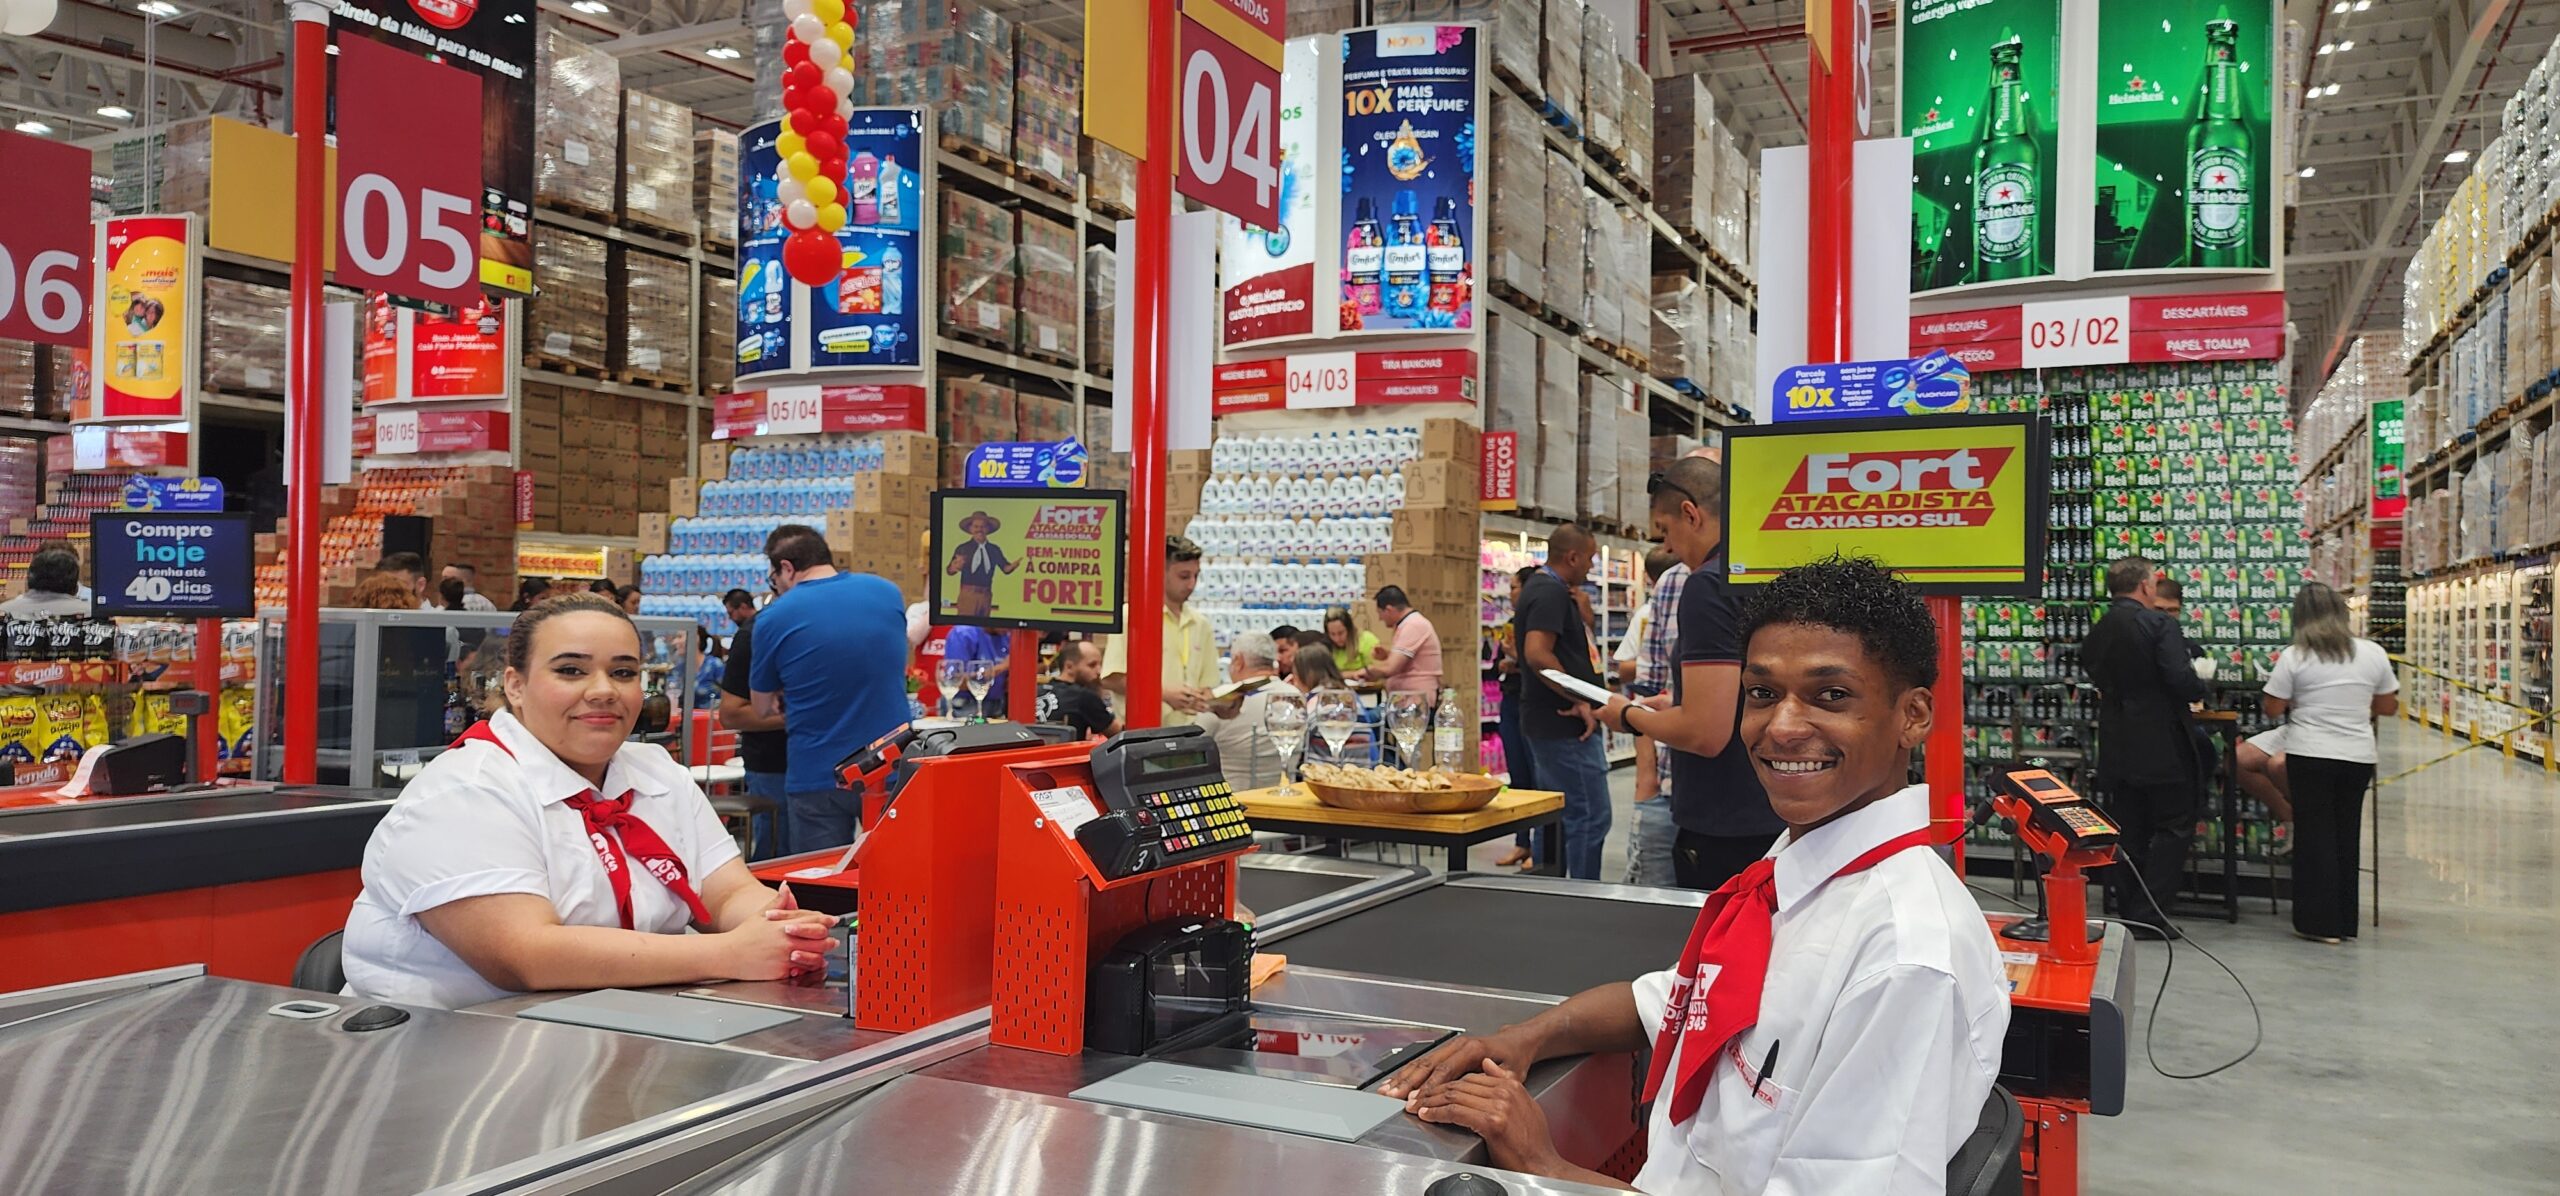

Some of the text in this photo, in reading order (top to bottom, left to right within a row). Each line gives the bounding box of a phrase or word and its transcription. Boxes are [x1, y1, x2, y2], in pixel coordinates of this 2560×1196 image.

[380, 15, 400, 34] da
[437, 36, 467, 57] para
[468, 48, 491, 67] sua
[491, 57, 523, 79] mesa
[1397, 86, 1434, 98] MAIS
[1345, 88, 1394, 116] 10X
[1183, 49, 1277, 209] 04
[344, 173, 473, 290] 05
[0, 243, 83, 334] 6
[2162, 305, 2249, 319] DESCARTÁVEIS
[1946, 319, 1988, 332] ROUPAS
[2166, 337, 2250, 351] PAPEL TOALHA
[1796, 369, 1826, 378] Parcele
[1786, 385, 1835, 409] 10x
[978, 460, 1008, 478] 10x
[1497, 436, 1514, 498] PREÇOS
[1807, 448, 1985, 494] Fort
[179, 478, 200, 493] 40
[1771, 491, 1994, 512] ATACADISTA
[1040, 505, 1099, 525] Fort
[1785, 513, 1969, 529] CAXIAS DO SUL
[125, 521, 213, 541] Compre
[1029, 525, 1101, 533] ATACADISTA
[137, 539, 206, 568] hoje
[1026, 547, 1101, 559] BEM-VINDO
[148, 567, 183, 577] tenha
[183, 567, 206, 577] até
[1038, 562, 1101, 575] COMPRA
[125, 576, 213, 602] 40 dias
[1023, 579, 1103, 606] FORT!
[14, 634, 35, 646] 2.0
[51, 634, 71, 646] 2.0
[83, 633, 103, 646] 2.0
[15, 766, 59, 785] emalo
[1132, 850, 1148, 872] 3
